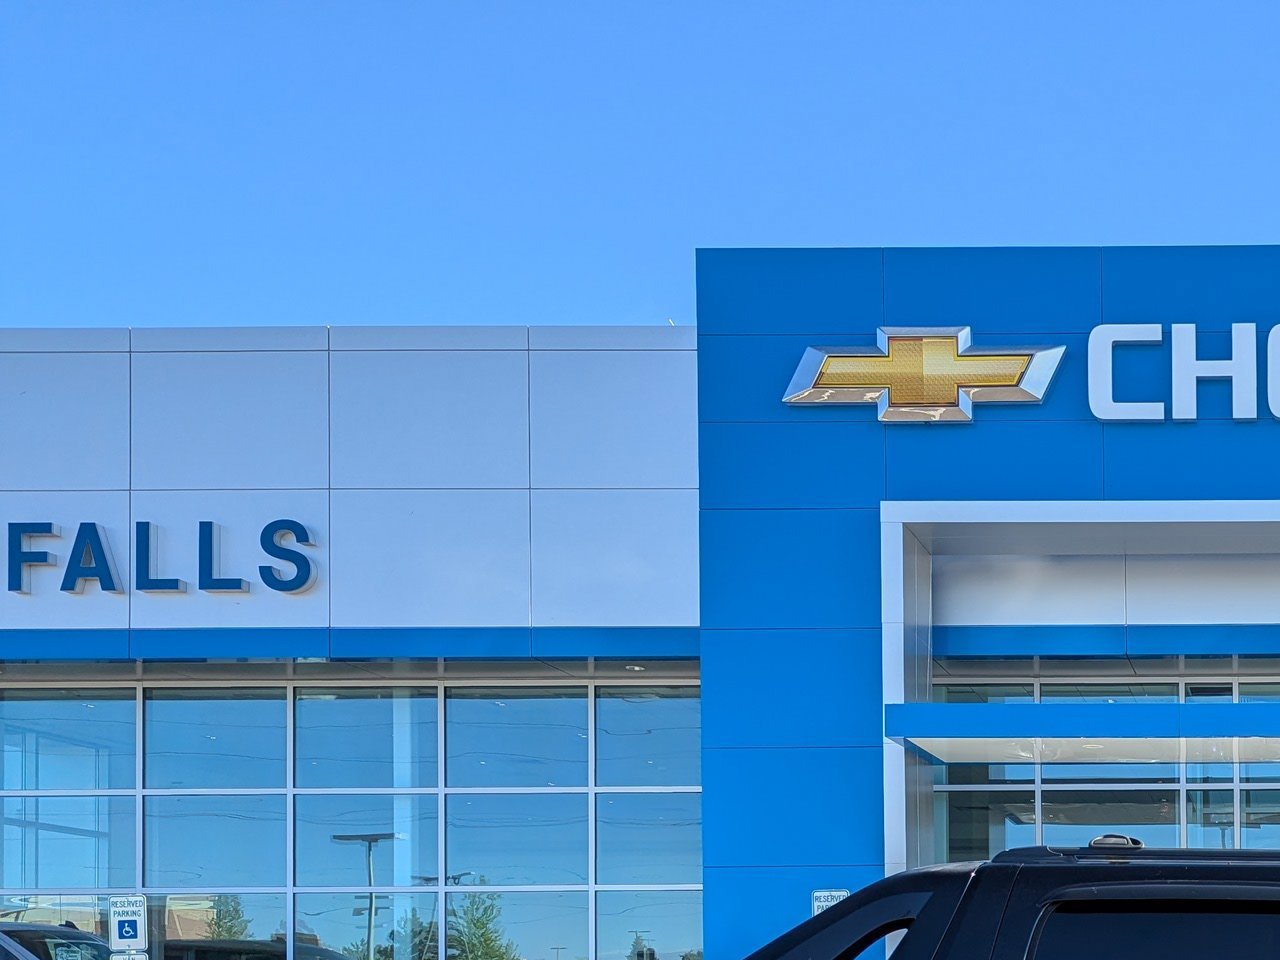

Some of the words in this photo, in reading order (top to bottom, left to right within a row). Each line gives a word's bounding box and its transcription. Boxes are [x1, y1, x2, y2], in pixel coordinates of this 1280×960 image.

[7, 518, 318, 594] FALLS
[111, 900, 143, 908] RESERVED
[113, 909, 142, 918] PARKING
